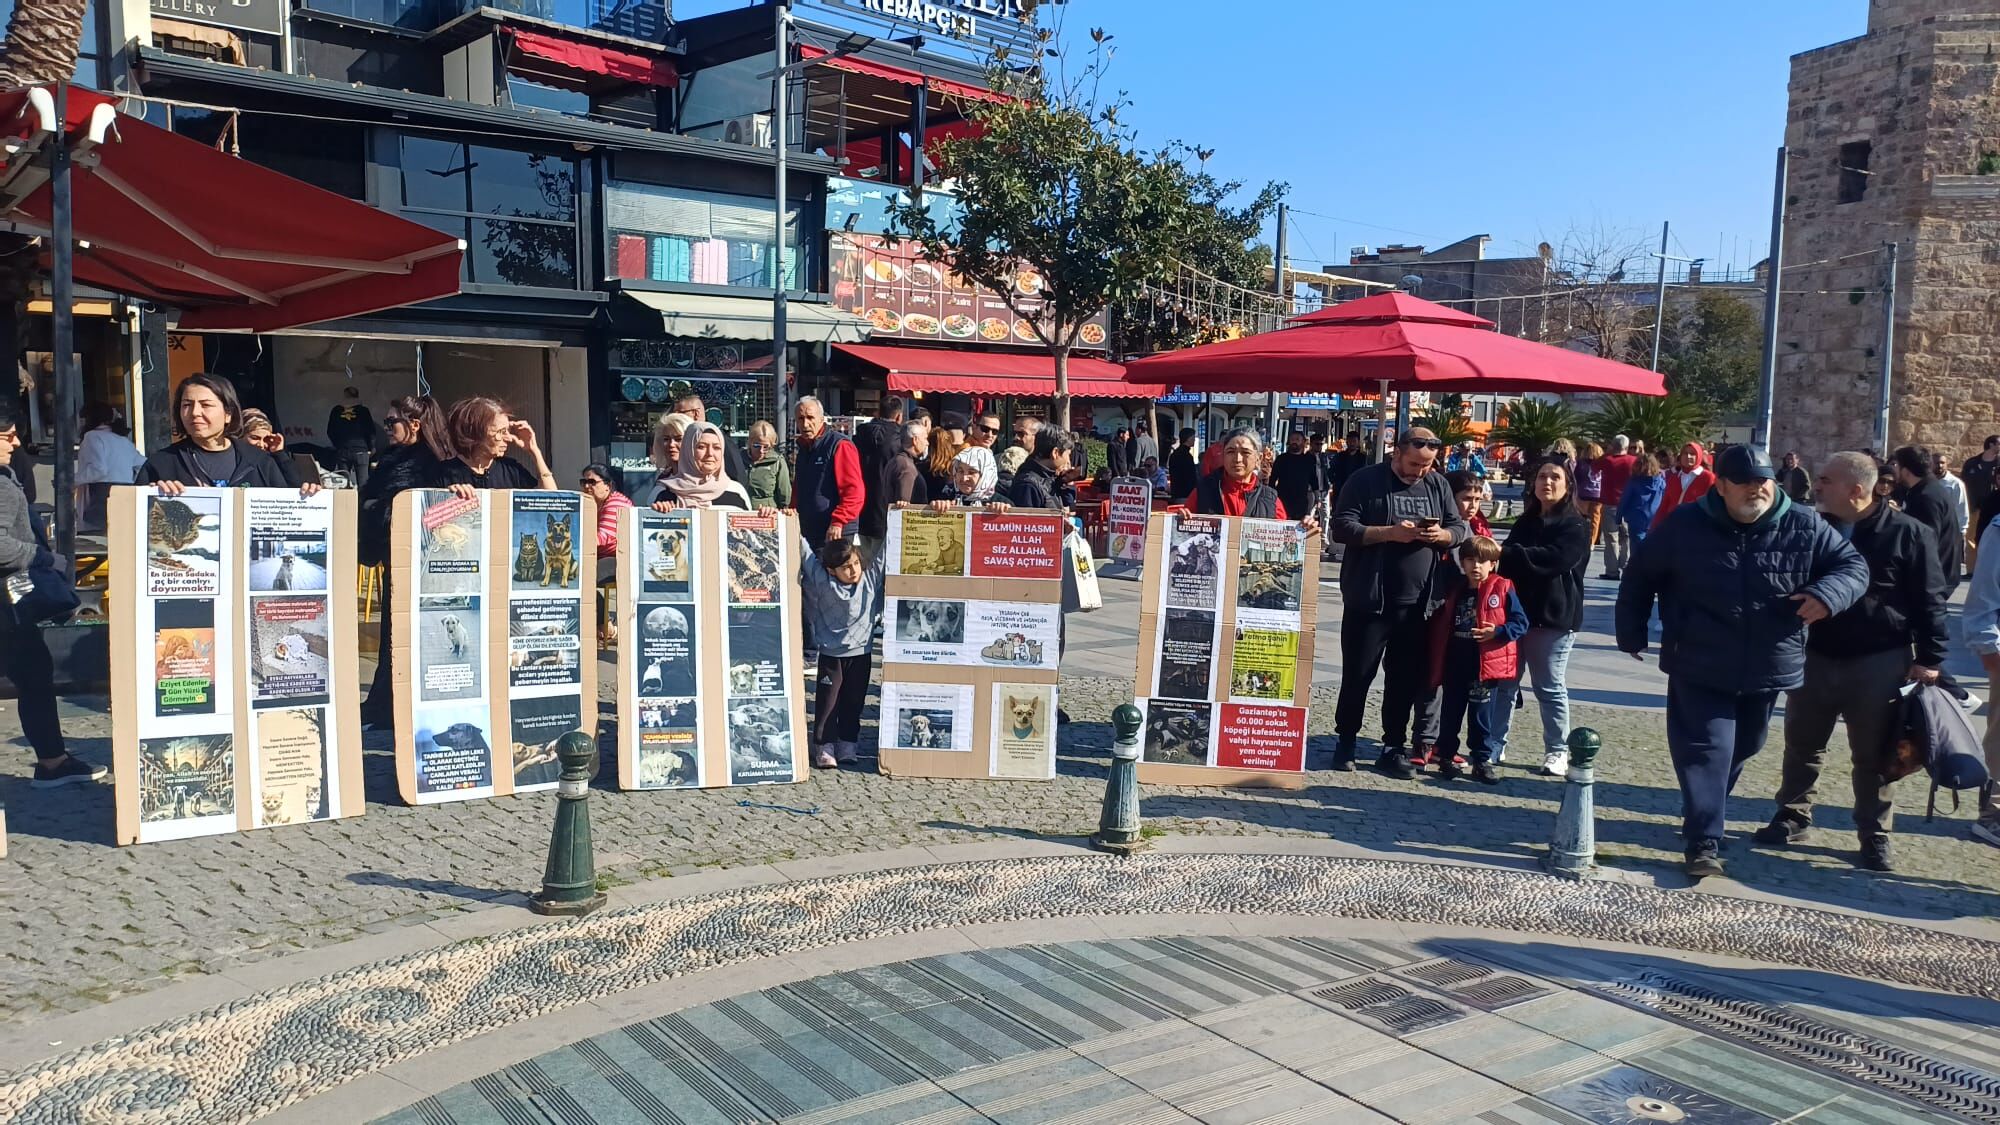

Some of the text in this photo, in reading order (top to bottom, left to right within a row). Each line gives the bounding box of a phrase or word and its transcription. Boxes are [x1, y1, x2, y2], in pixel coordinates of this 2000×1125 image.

[1352, 399, 1373, 407] COFFEE
[1112, 495, 1145, 505] WATCH
[983, 522, 1055, 534] ZULMÜN HASMI
[1011, 536, 1042, 544] ALLAH
[992, 544, 1046, 555] SİZ ALLAHA
[984, 557, 1054, 568] SAVAŞ AÇTINIZ
[151, 585, 215, 594] doyurmaktır
[1268, 634, 1288, 643] Şahin
[1239, 707, 1287, 717] Gaziantep'te
[1224, 726, 1300, 738] köpeği kafeslerdeki
[1229, 737, 1293, 748] vahşi hayvanlara
[1257, 748, 1282, 756] olarak
[430, 758, 453, 766] OLARAK
[751, 761, 779, 769] SUSMA
[1243, 758, 1277, 767] verilmiş!
